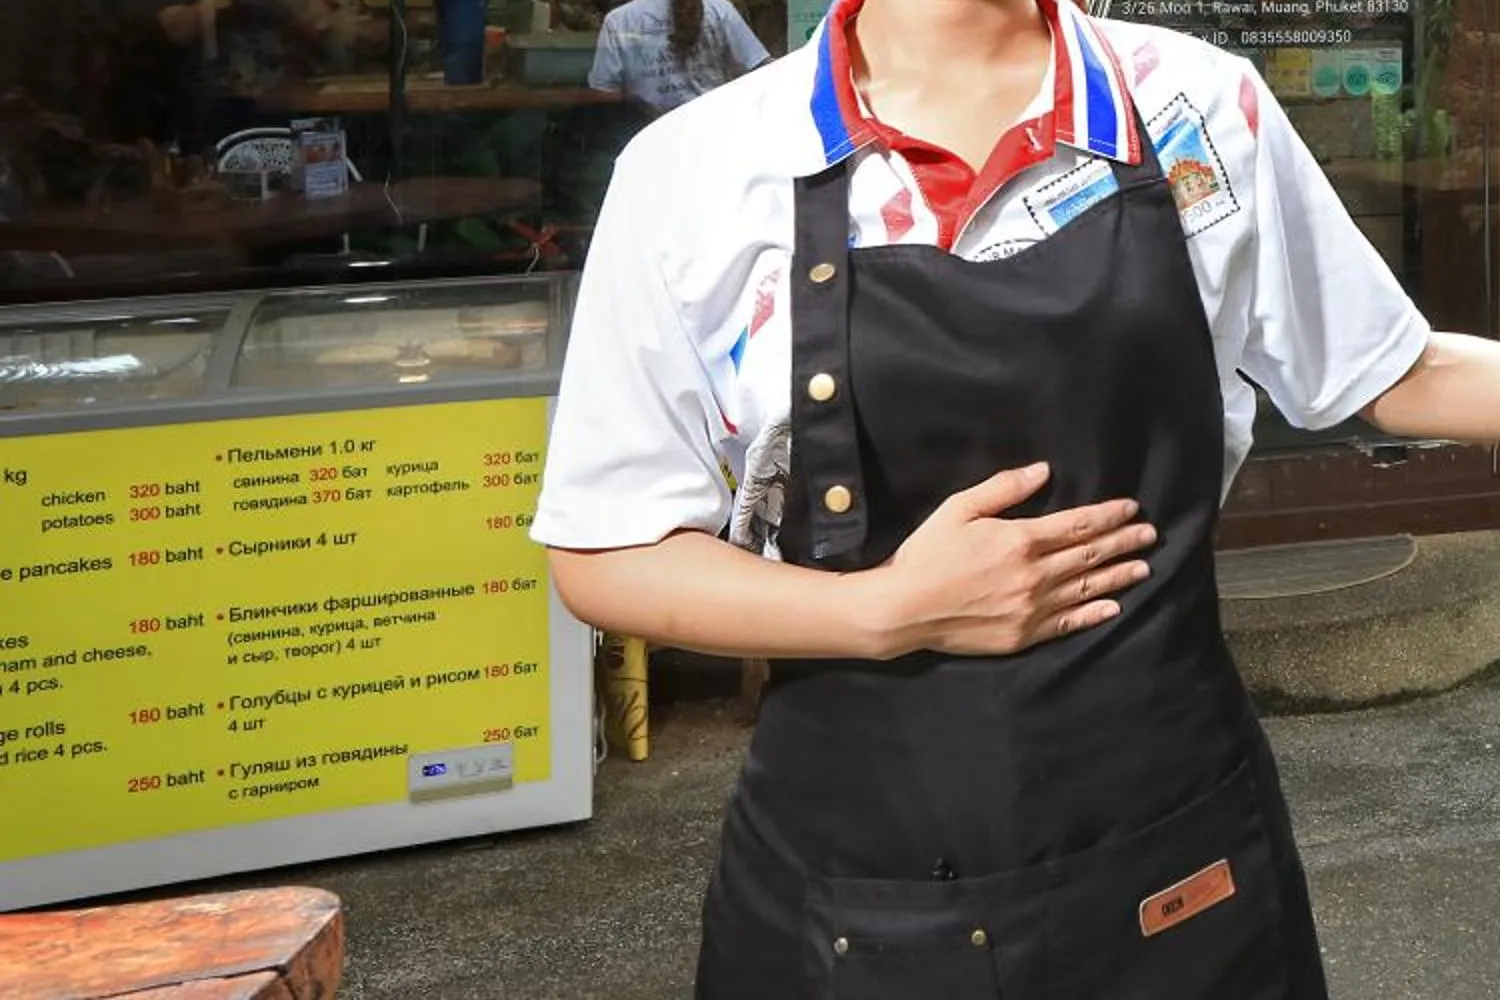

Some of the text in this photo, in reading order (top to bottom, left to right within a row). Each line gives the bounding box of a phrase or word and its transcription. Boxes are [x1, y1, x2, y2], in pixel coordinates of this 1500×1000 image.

[1121, 1, 1155, 16] 3/26
[1315, 0, 1363, 14] Phuket
[1366, 0, 1410, 14] 83130
[1240, 29, 1352, 45] 0835558009350
[227, 438, 376, 464] Пельмени 1.0 кг
[4, 468, 28, 486] kg
[233, 450, 540, 489] свинина 320 бат курица 320 бат
[41, 480, 201, 508] chicken 320 baht
[232, 472, 539, 512] говядина 370 бат картофель 300 бат
[41, 503, 202, 533] potatoes 300 baht
[486, 513, 534, 530] 180 ба
[228, 532, 357, 558] Сырники 4 шт
[19, 556, 113, 582] pancakes
[128, 550, 161, 567] 180
[165, 547, 204, 563] baht
[228, 578, 537, 624] Блинчики фаршированные 180 бат
[129, 614, 204, 634] 180 baht
[373, 610, 436, 627] ветчина
[42, 652, 77, 669] and
[226, 654, 238, 666] и
[283, 640, 341, 660] творог)
[345, 638, 356, 651] 4
[359, 636, 381, 650] шт
[9, 677, 64, 698] 4 pcs.
[229, 662, 538, 712] Голубцы с курицей и рисом 180 бат
[128, 703, 205, 725] 180 baht
[227, 718, 266, 732] 4 шт
[25, 720, 66, 738] rolls
[482, 725, 539, 743] 250 бат
[15, 746, 49, 763] rice
[54, 743, 66, 757] 4
[71, 739, 109, 759] pcs.
[229, 743, 409, 779] Гуляш из говядины
[127, 770, 205, 793] 250 baht
[228, 776, 320, 800] с гарниром
